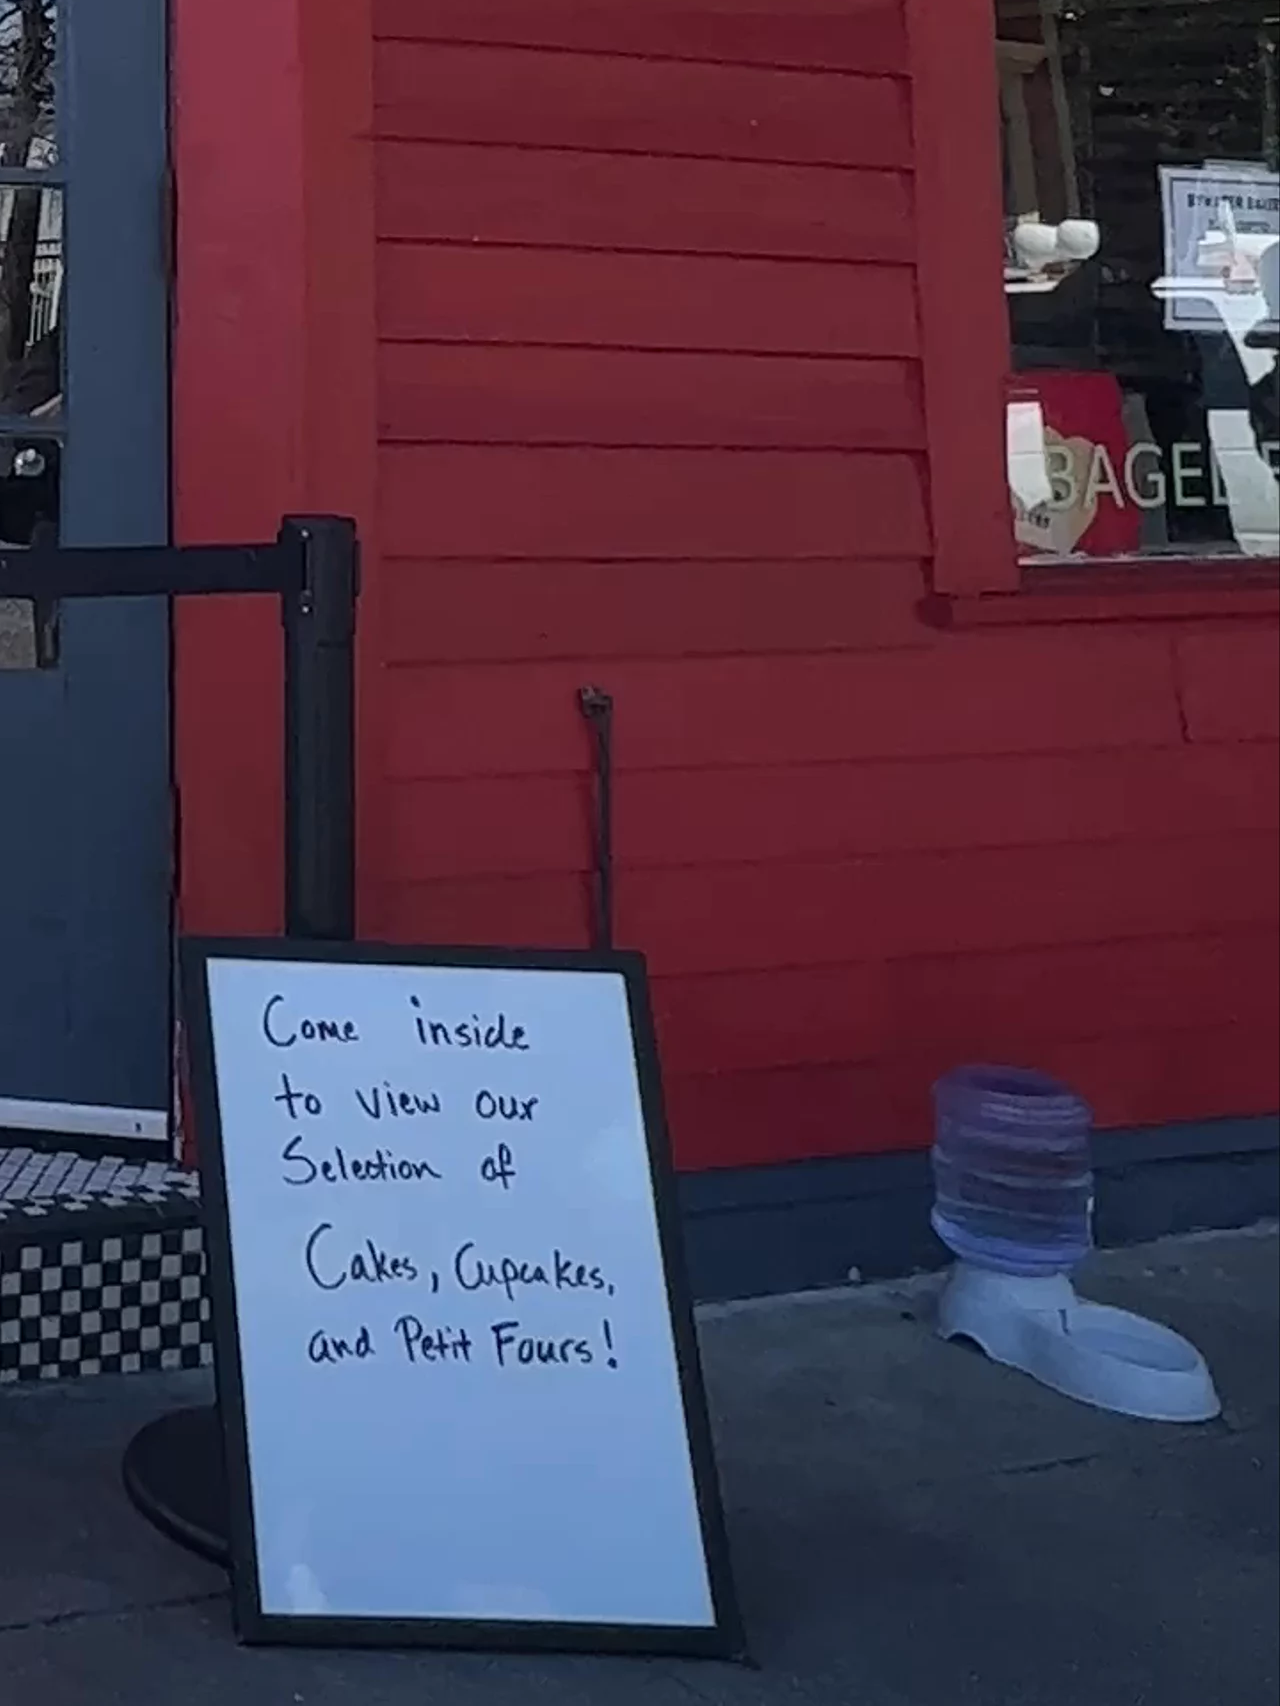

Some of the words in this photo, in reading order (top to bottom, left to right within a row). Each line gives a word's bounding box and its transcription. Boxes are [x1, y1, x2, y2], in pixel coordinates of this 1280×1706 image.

[262, 994, 360, 1049] Come
[409, 996, 531, 1051] inside
[274, 1073, 323, 1119] to
[355, 1081, 442, 1120] view
[474, 1086, 542, 1123] our
[281, 1135, 443, 1186] Selection
[480, 1143, 518, 1190] of
[307, 1329, 375, 1365] and
[394, 1314, 473, 1365] Petit
